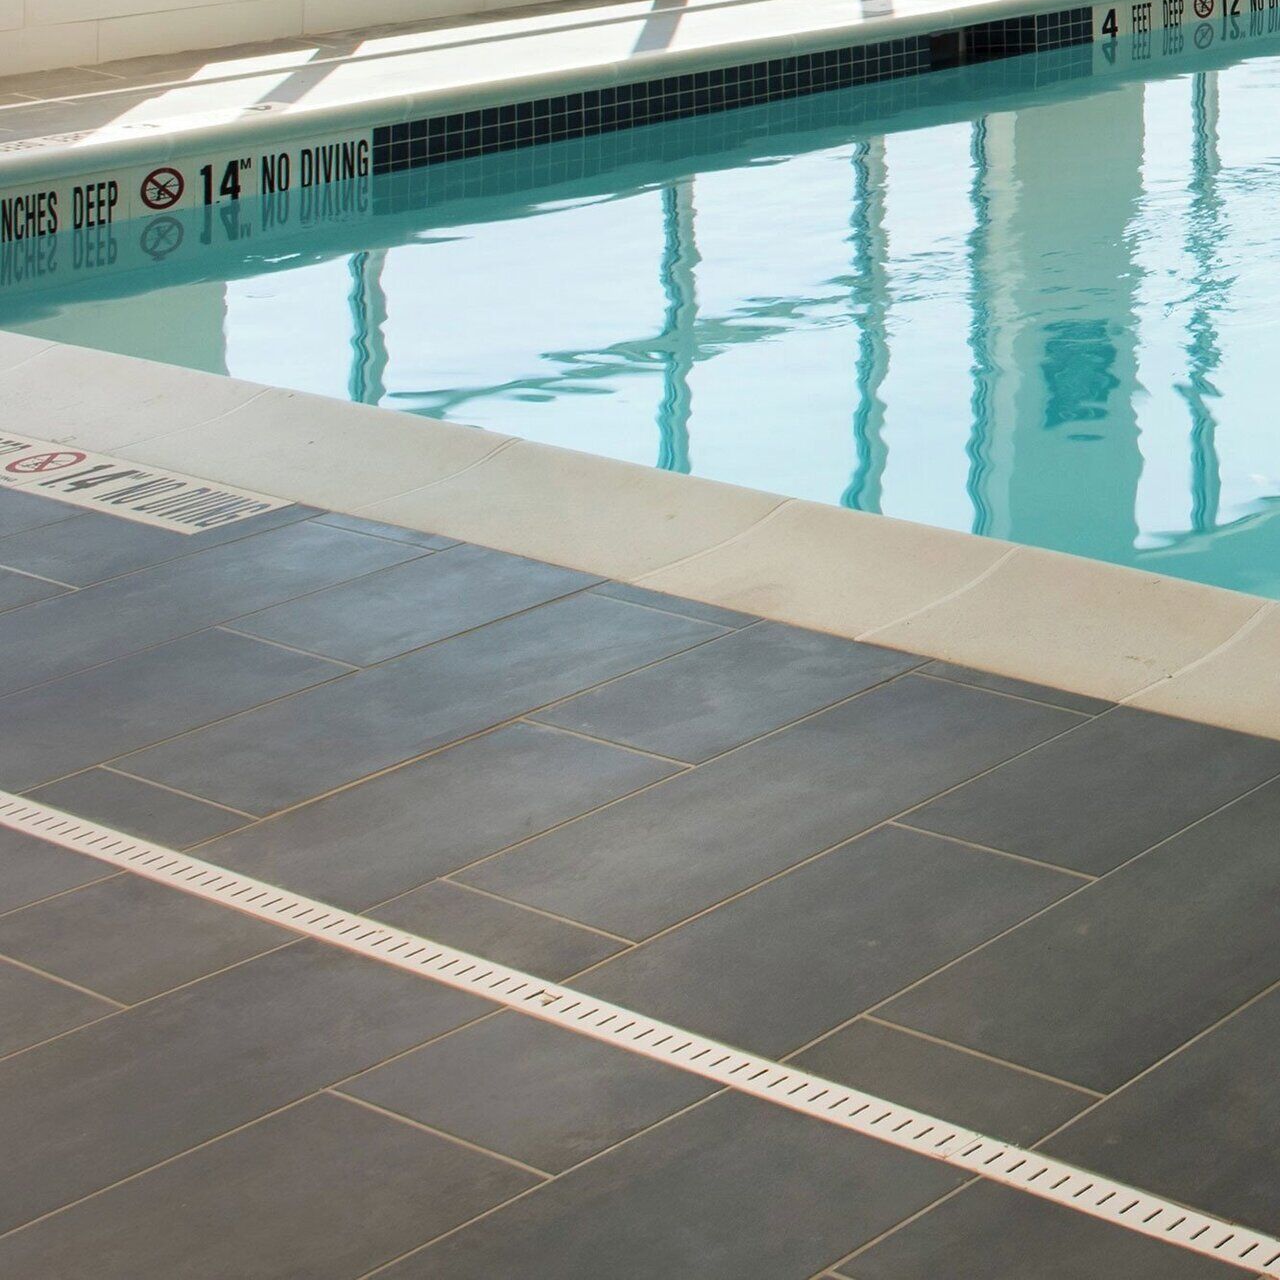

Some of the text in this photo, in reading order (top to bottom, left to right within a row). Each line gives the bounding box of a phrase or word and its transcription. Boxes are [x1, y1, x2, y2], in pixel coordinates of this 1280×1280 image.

[1102, 8, 1118, 37] 4
[1132, 2, 1152, 33] FEET
[74, 181, 118, 229] DEEP
[262, 153, 290, 195] NO
[301, 139, 369, 188] DIVING
[93, 477, 187, 505] NO
[131, 487, 272, 527] DIVING
